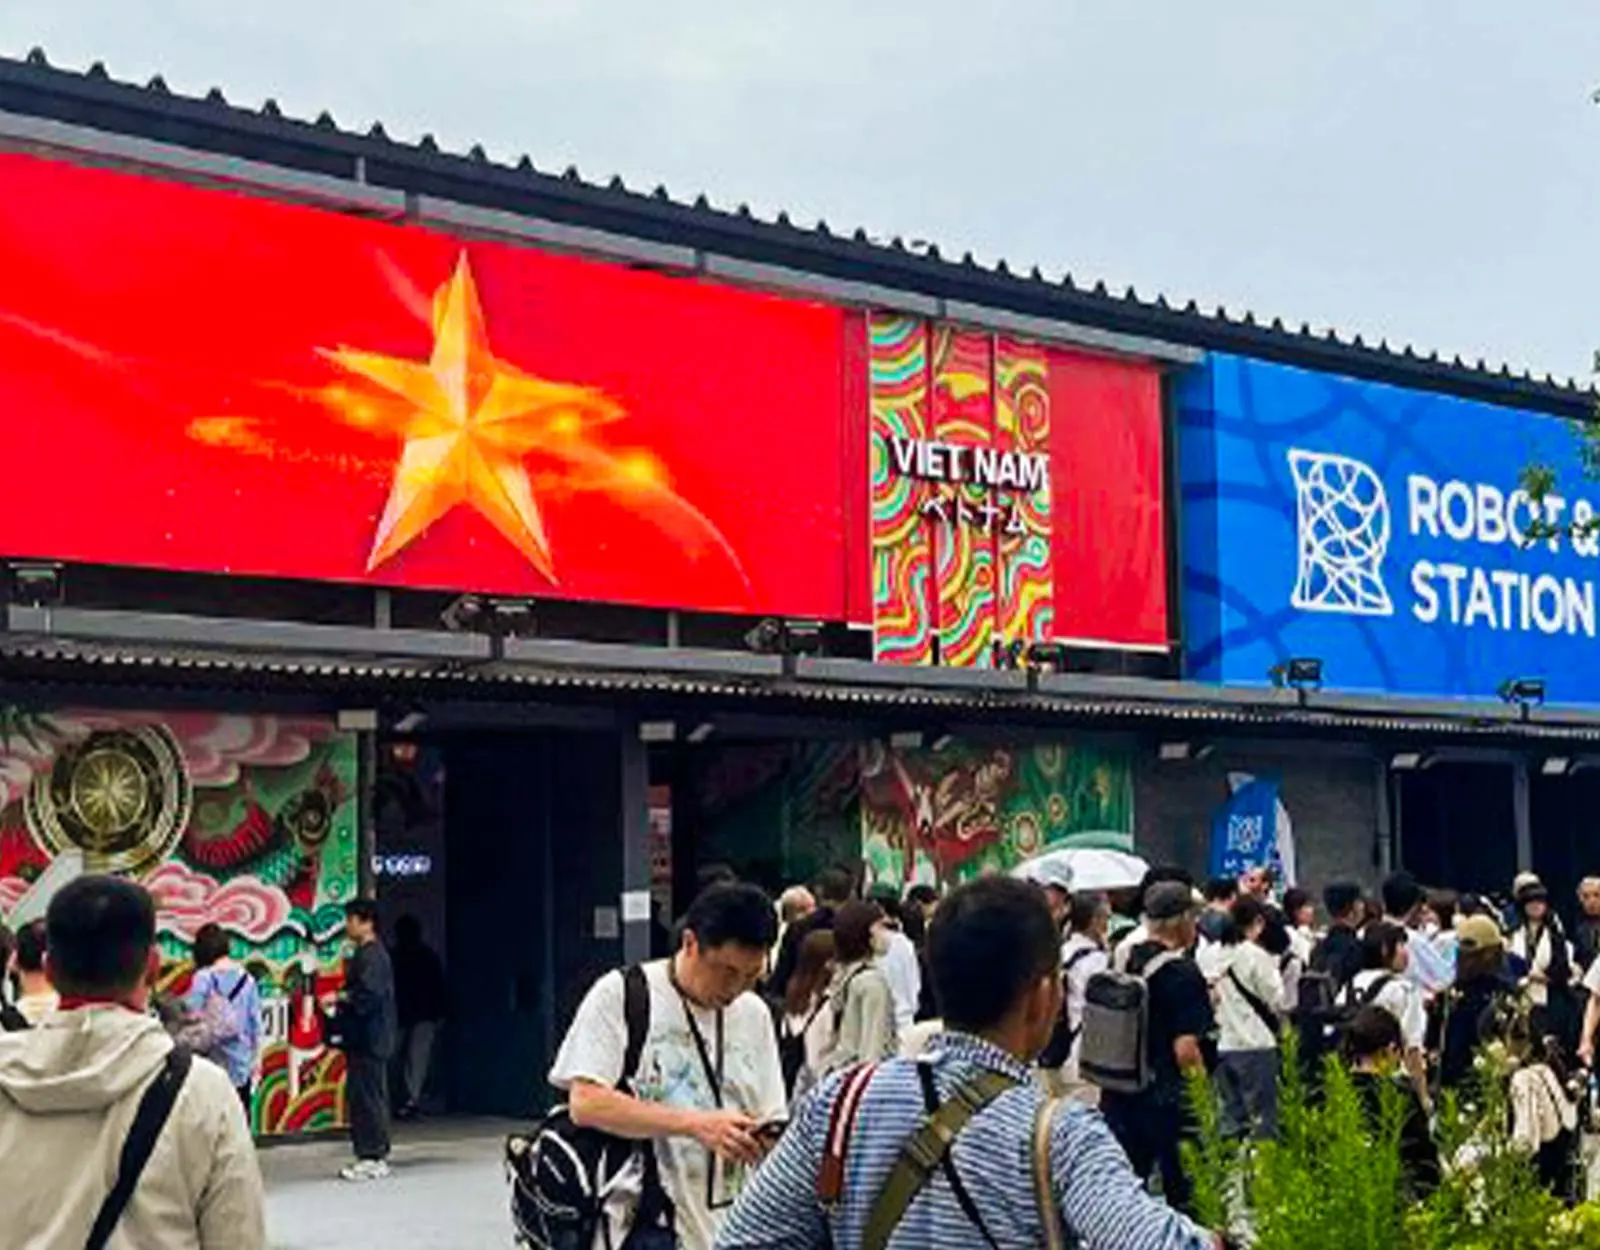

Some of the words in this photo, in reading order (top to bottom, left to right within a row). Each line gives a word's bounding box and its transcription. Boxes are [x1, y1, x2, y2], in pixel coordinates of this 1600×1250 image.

[891, 436, 968, 480] VIET
[974, 446, 1050, 491] NAM
[1408, 474, 1566, 553] ROBOT
[1410, 560, 1596, 638] STATION
